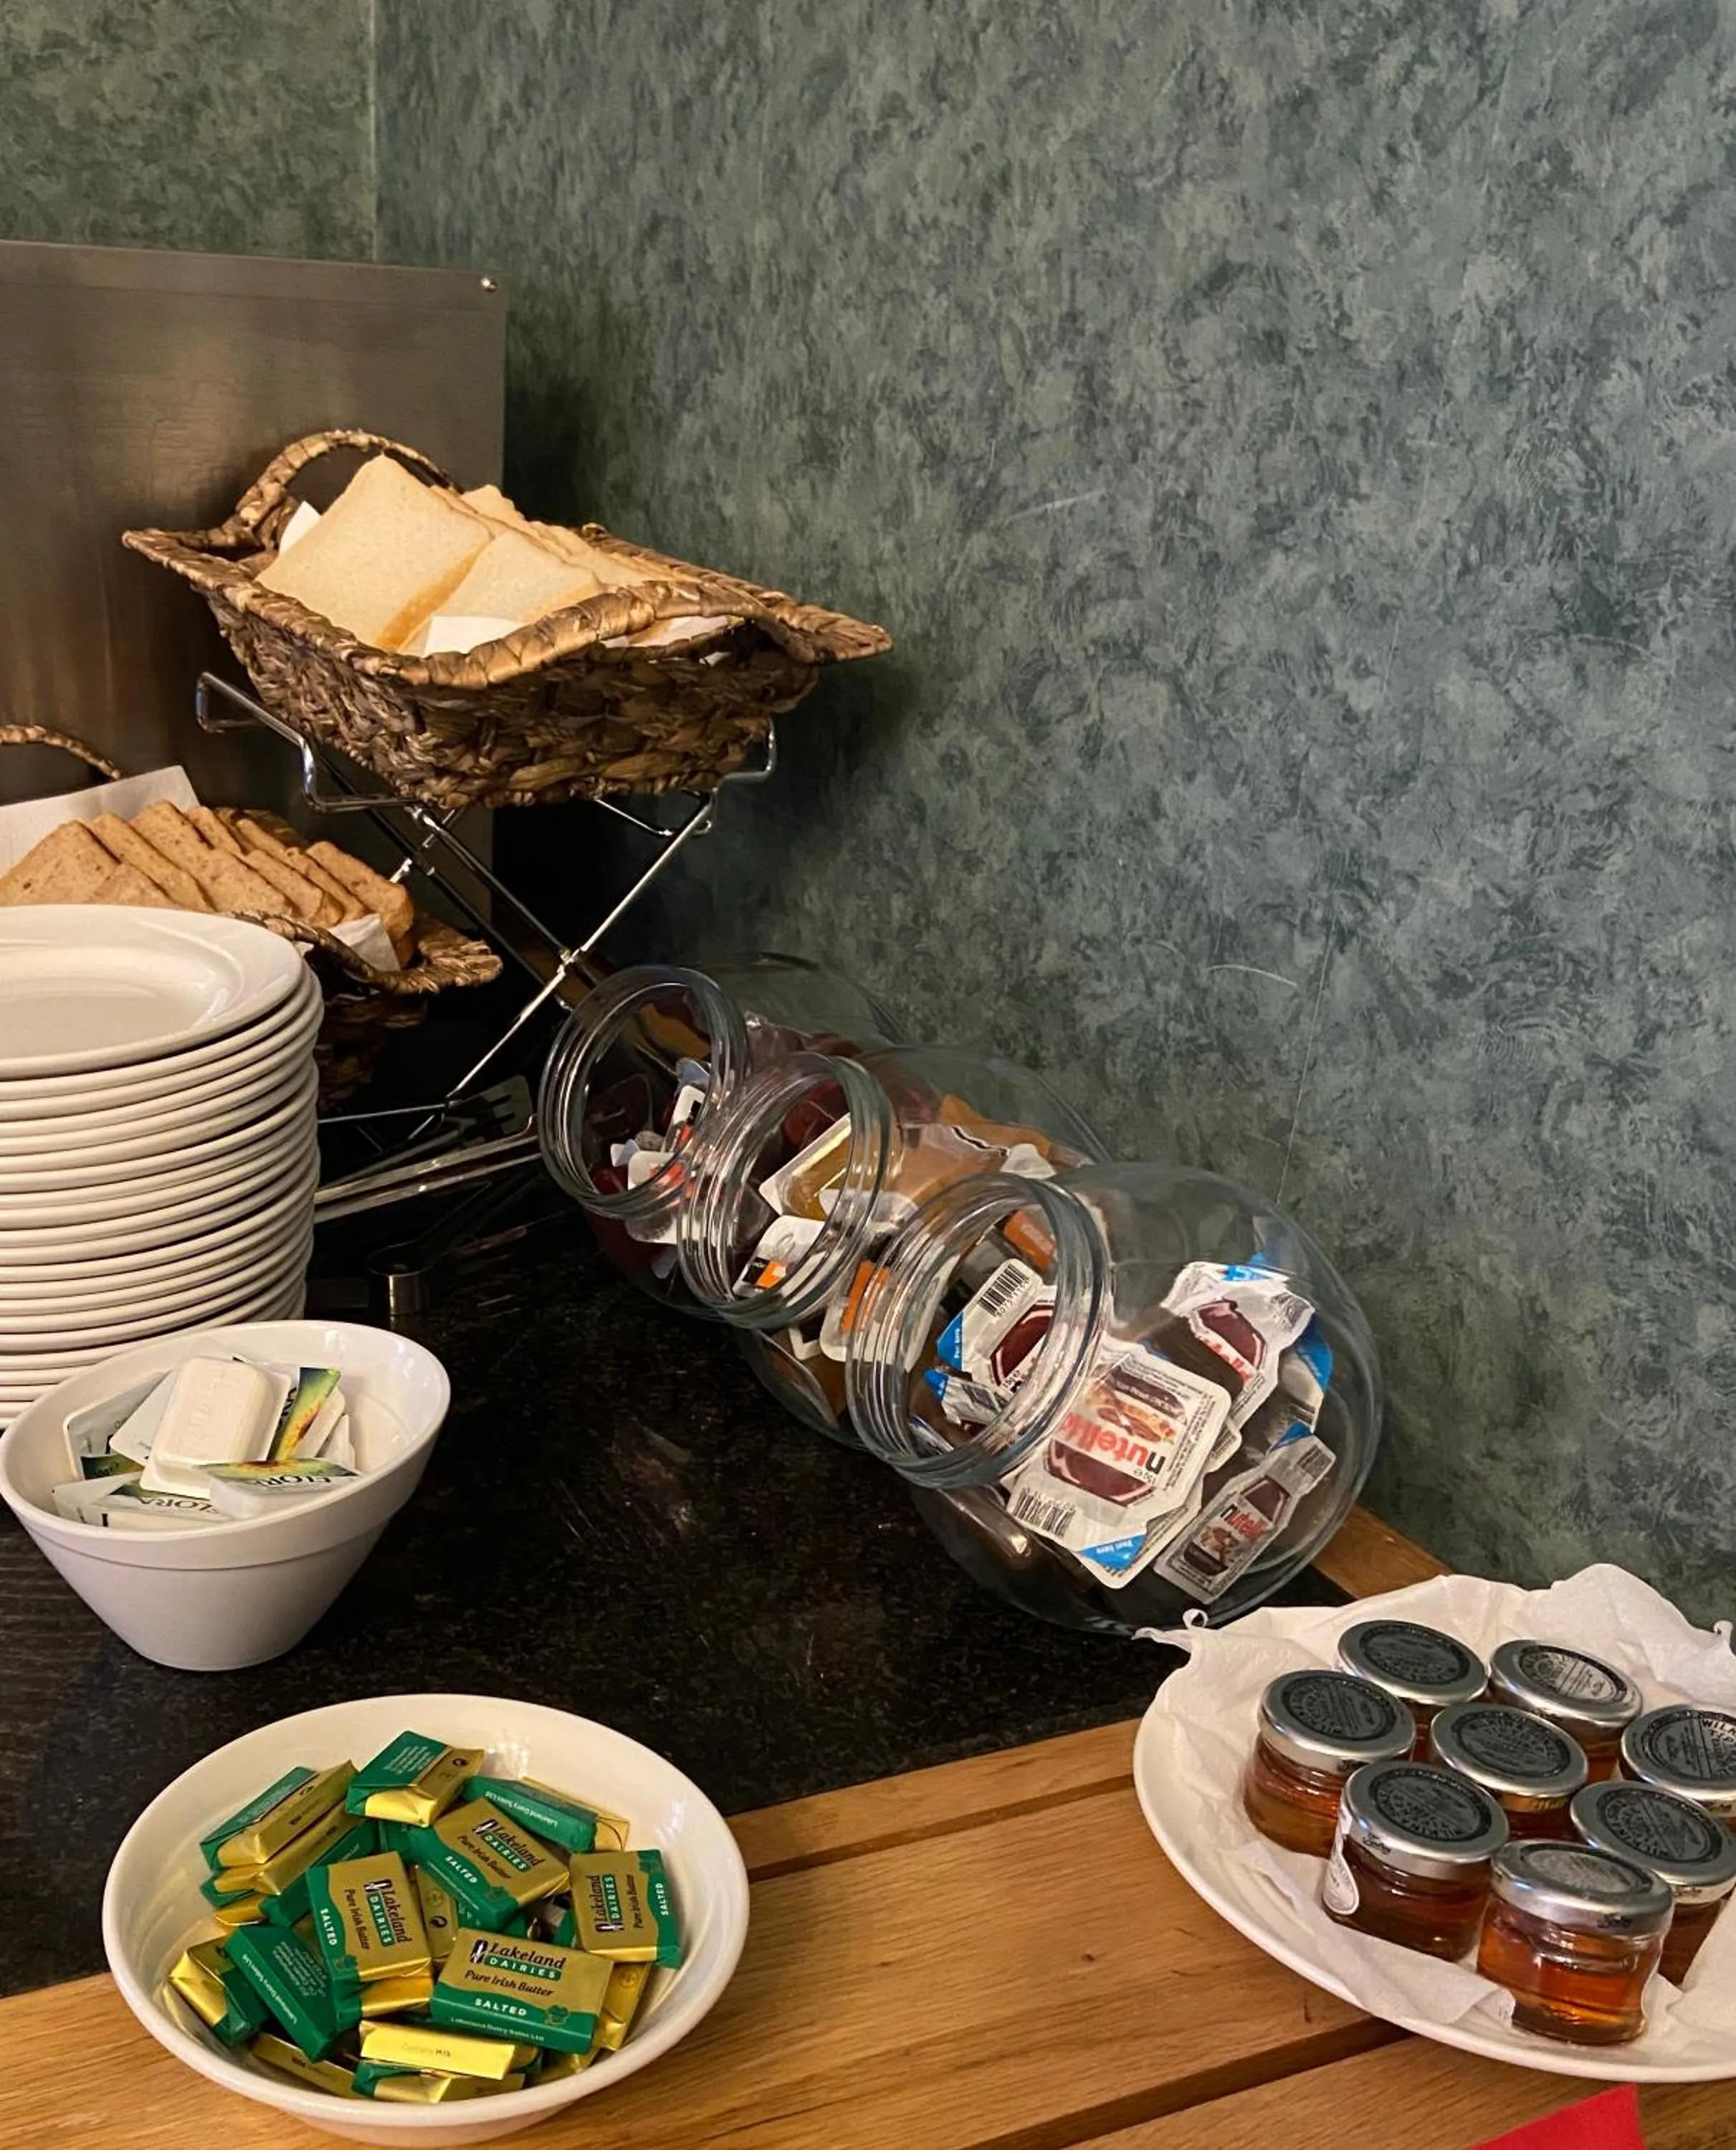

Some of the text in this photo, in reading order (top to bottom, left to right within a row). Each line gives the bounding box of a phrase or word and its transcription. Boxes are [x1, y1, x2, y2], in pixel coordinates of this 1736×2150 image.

[484, 1835, 528, 1870] DAIRIES
[493, 1826, 545, 1867] Lakeland
[444, 1855, 478, 1883] SALTED
[344, 1888, 357, 1906] Pure
[585, 1874, 608, 1921] Lakeland
[604, 1876, 620, 1919] DAIRIES
[654, 1883, 669, 1916] SALTED
[320, 1908, 338, 1946] SALTED
[369, 1896, 393, 1944] DAIRIES
[382, 1889, 413, 1944] Lakeland
[489, 1941, 567, 1970] Lakeland
[489, 1957, 558, 1979] DAIRIES
[464, 1969, 555, 1997] Pure Irish Butter
[474, 1997, 528, 2017] SALTED
